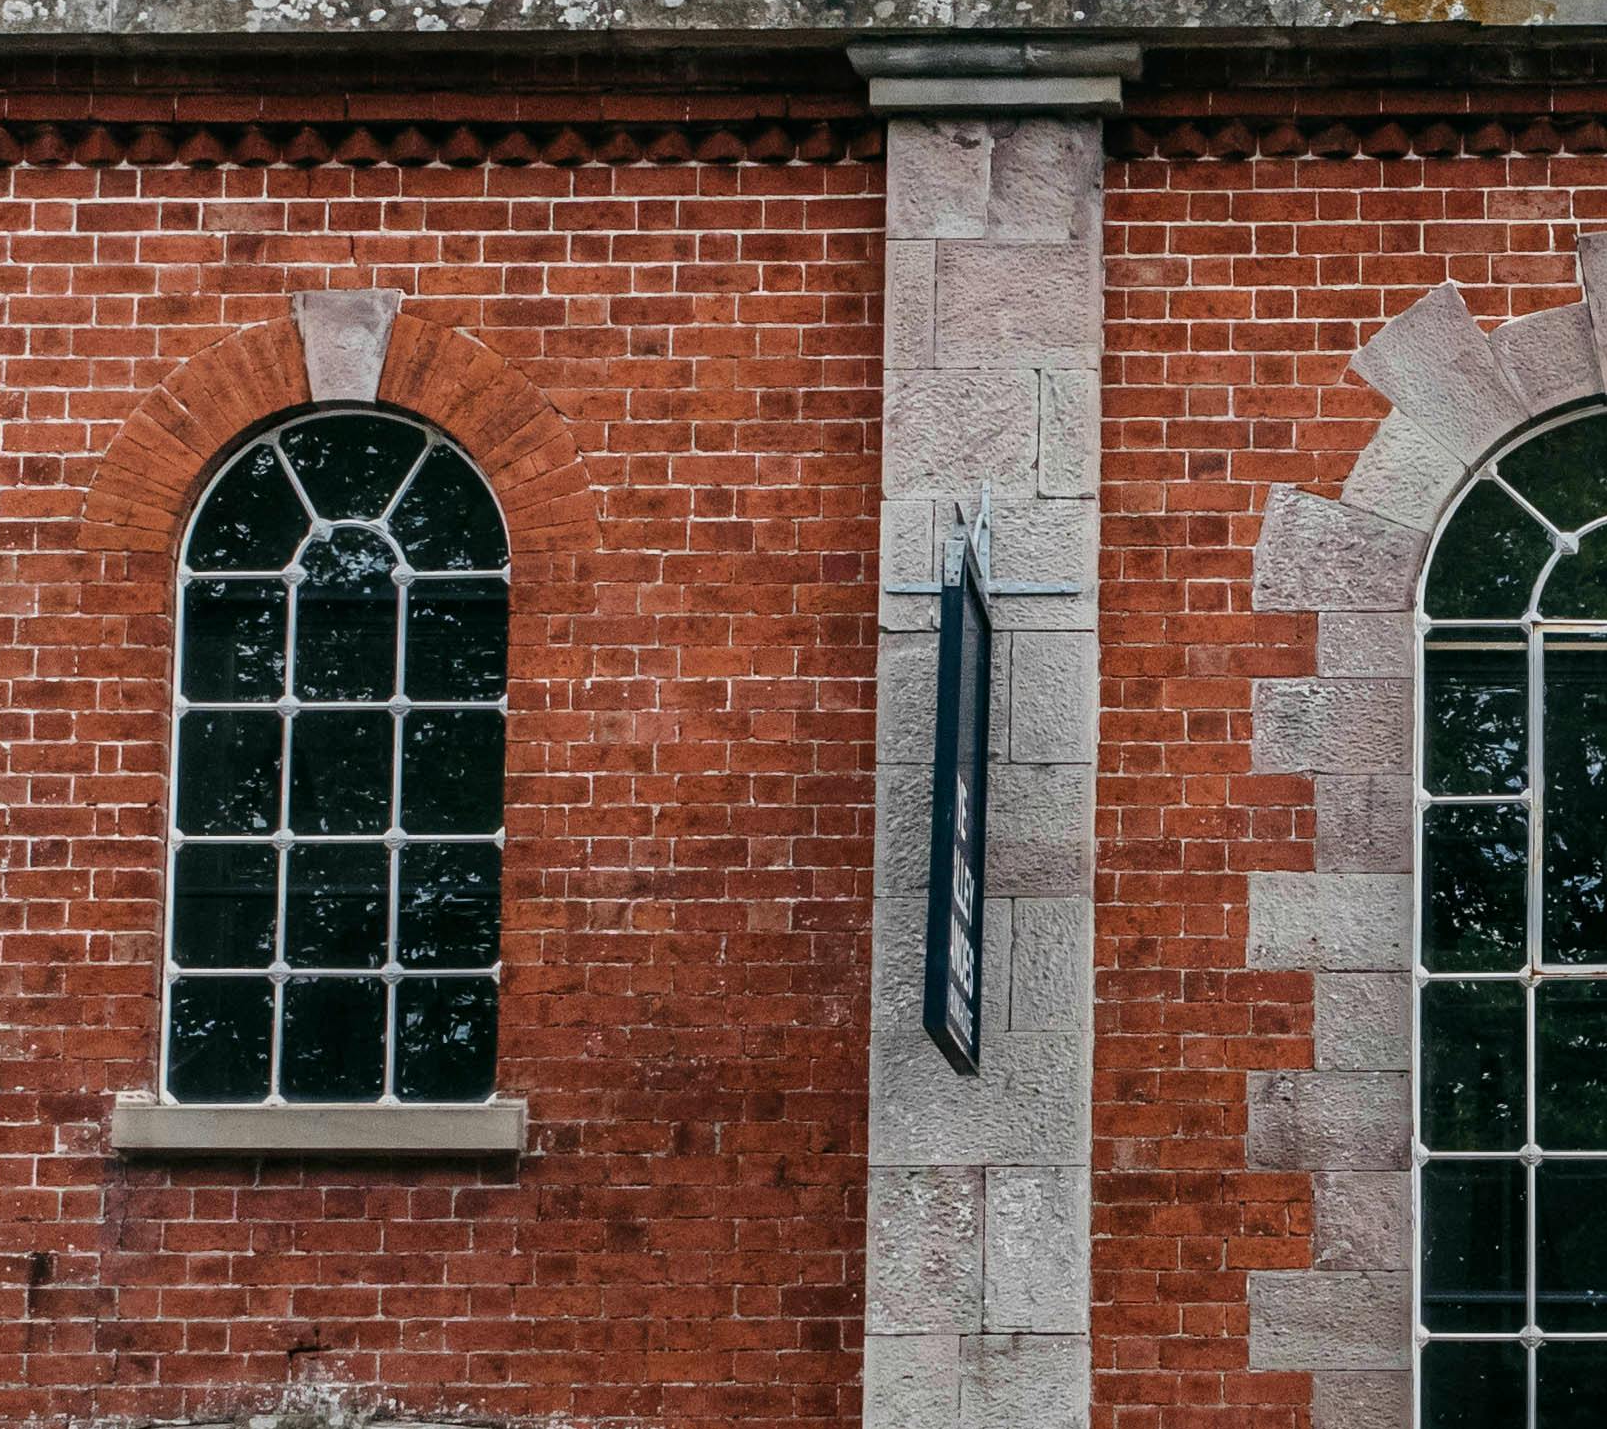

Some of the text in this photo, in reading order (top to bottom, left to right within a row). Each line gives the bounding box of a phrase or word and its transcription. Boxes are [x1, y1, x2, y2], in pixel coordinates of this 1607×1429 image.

[956, 770, 968, 841] YE
[953, 843, 975, 927] LLEY
[950, 913, 974, 1000] NOES
